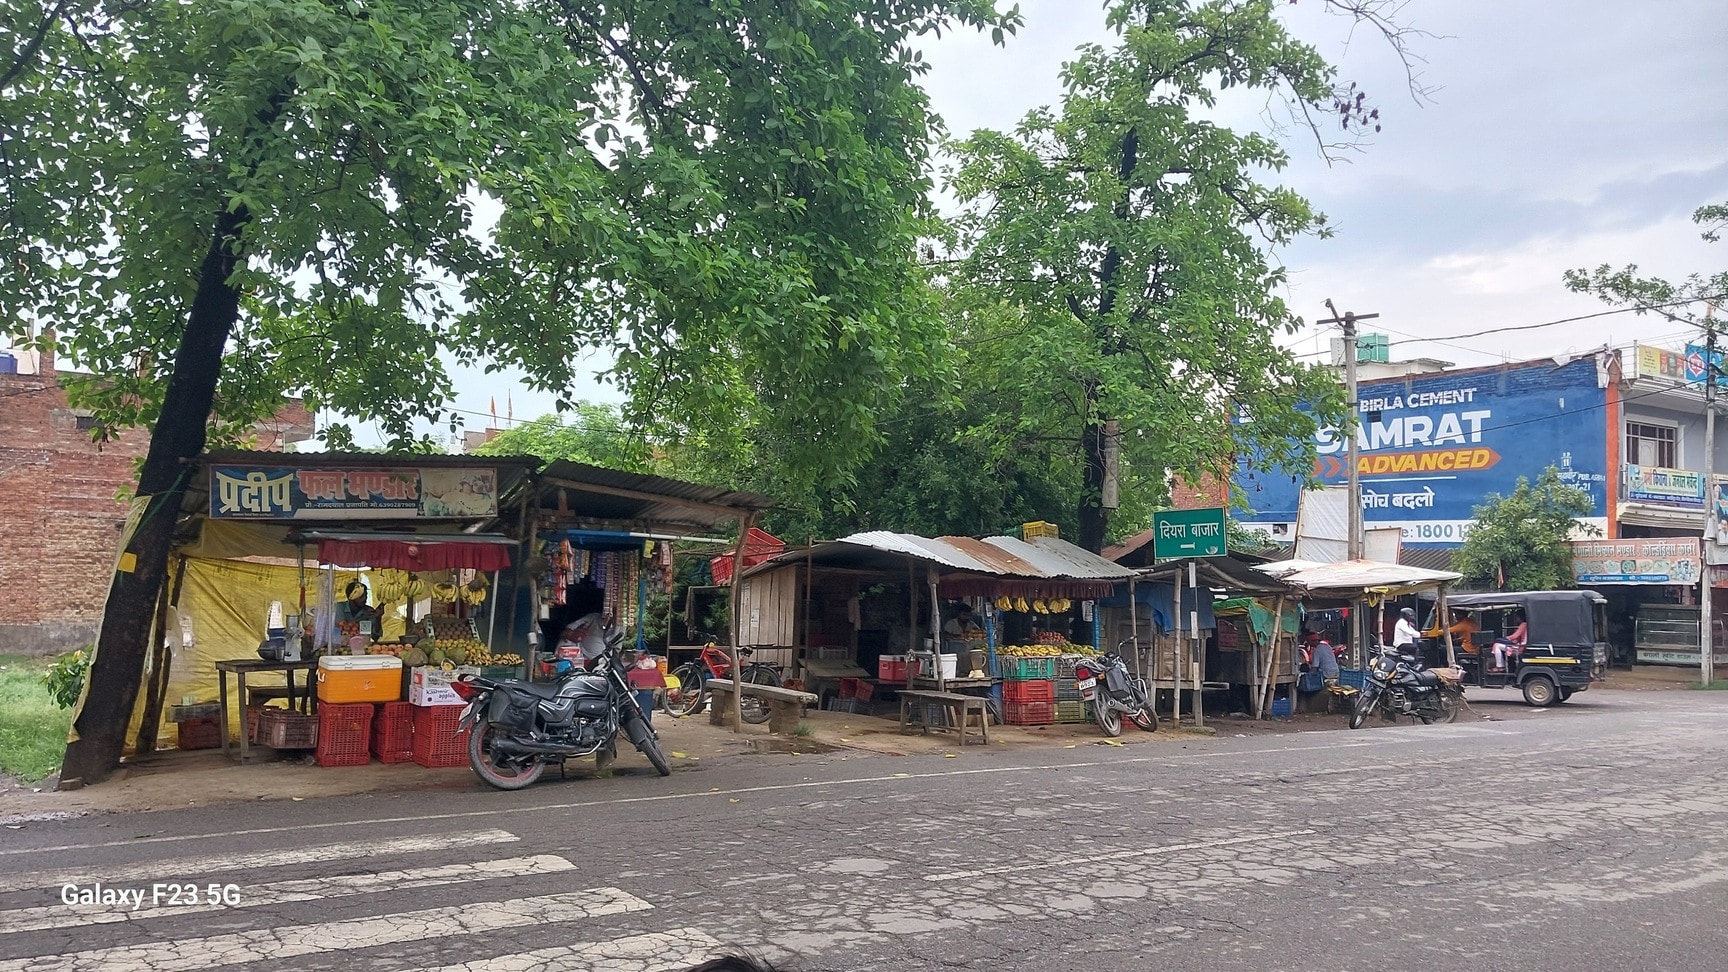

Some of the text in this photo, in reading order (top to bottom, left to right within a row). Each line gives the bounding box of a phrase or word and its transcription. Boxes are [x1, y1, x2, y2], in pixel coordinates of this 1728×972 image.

[1360, 388, 1477, 412] BIRLA CEMENT
[1315, 410, 1491, 454] SAMRAT
[1357, 449, 1490, 474] ADVANCED
[215, 471, 294, 514] प्रदीप
[296, 469, 347, 500] फल
[1361, 486, 1435, 509] सोच बदलो
[1160, 520, 1220, 539] दियरा बाजार
[1416, 524, 1453, 538] 1800
